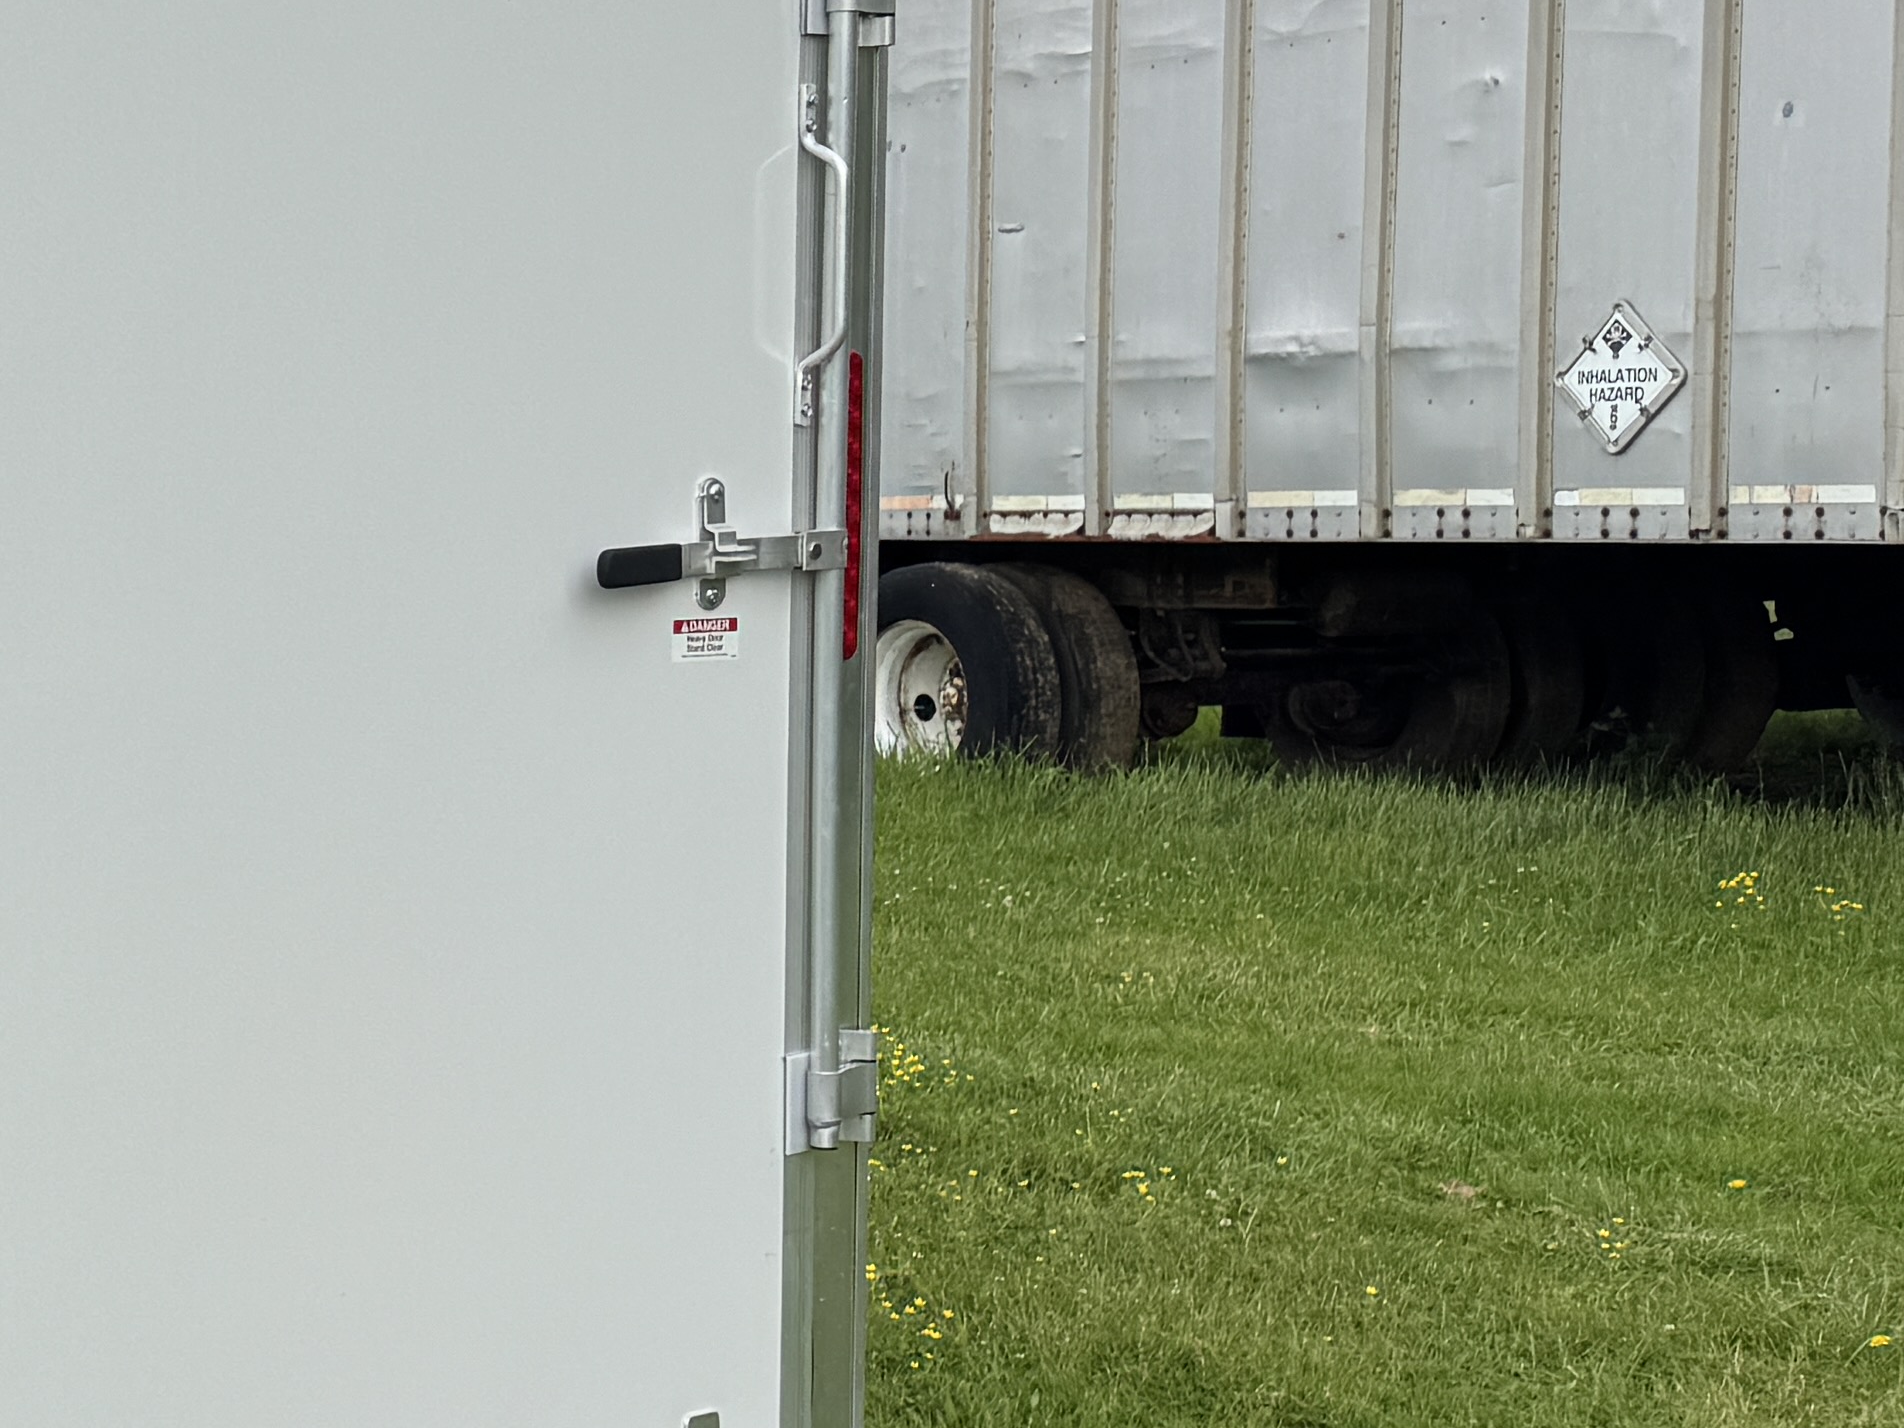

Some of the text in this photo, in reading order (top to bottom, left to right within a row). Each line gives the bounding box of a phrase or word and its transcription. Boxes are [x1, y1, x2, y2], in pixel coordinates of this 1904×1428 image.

[1578, 367, 1658, 385] INHALATION
[1589, 386, 1645, 403] HAZARD
[689, 619, 730, 632] DANGER
